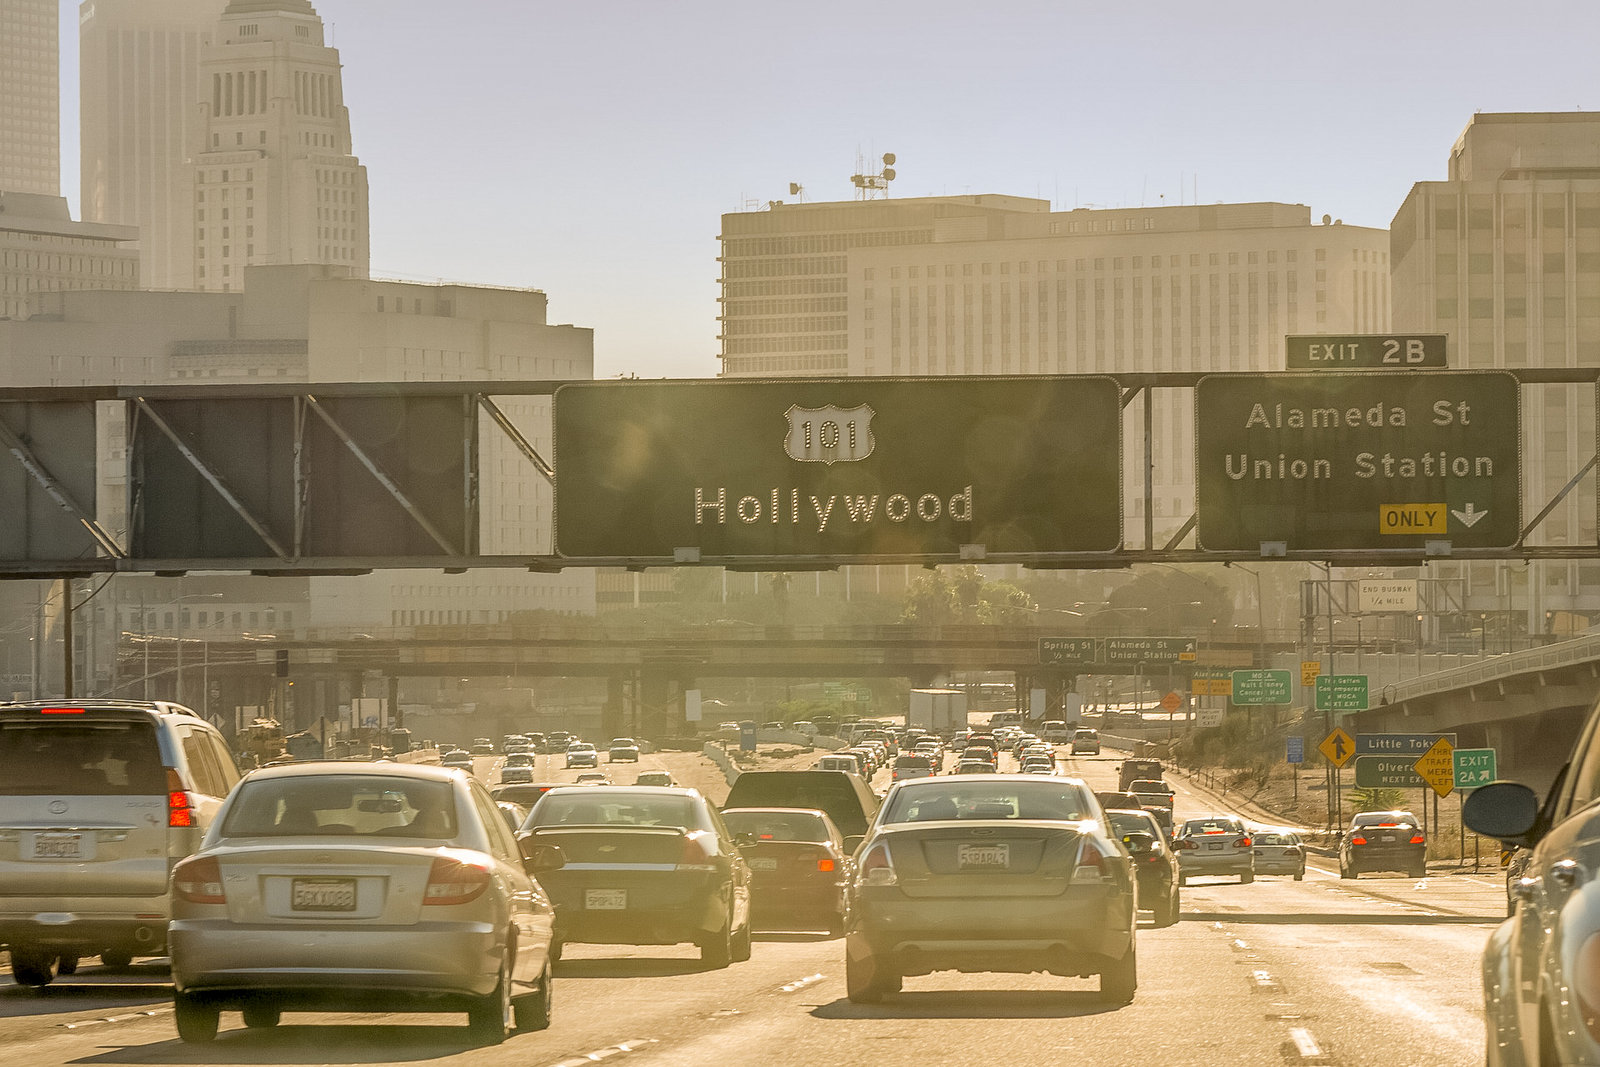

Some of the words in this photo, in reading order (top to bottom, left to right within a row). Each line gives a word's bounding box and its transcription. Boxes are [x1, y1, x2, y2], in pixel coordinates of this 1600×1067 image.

[1308, 343, 1360, 361] EXIT
[1382, 339, 1426, 364] 2B
[1245, 402, 1407, 429] Alameda
[1432, 400, 1471, 426] St
[801, 420, 856, 449] 101
[1225, 453, 1332, 480] Union
[1355, 451, 1494, 479] Station
[695, 485, 973, 534] Hollywood
[1386, 511, 1438, 527] ONLY
[1043, 641, 1075, 651] Spring
[1081, 641, 1091, 650] St
[1109, 641, 1150, 649] Alameda
[1157, 641, 1167, 649] St
[1143, 651, 1178, 659] Station
[1318, 686, 1367, 694] Conemporary
[1368, 739, 1401, 749] Little
[1409, 739, 1434, 749] Tok
[1459, 756, 1489, 767] EXIT
[1459, 771, 1476, 783] 2A
